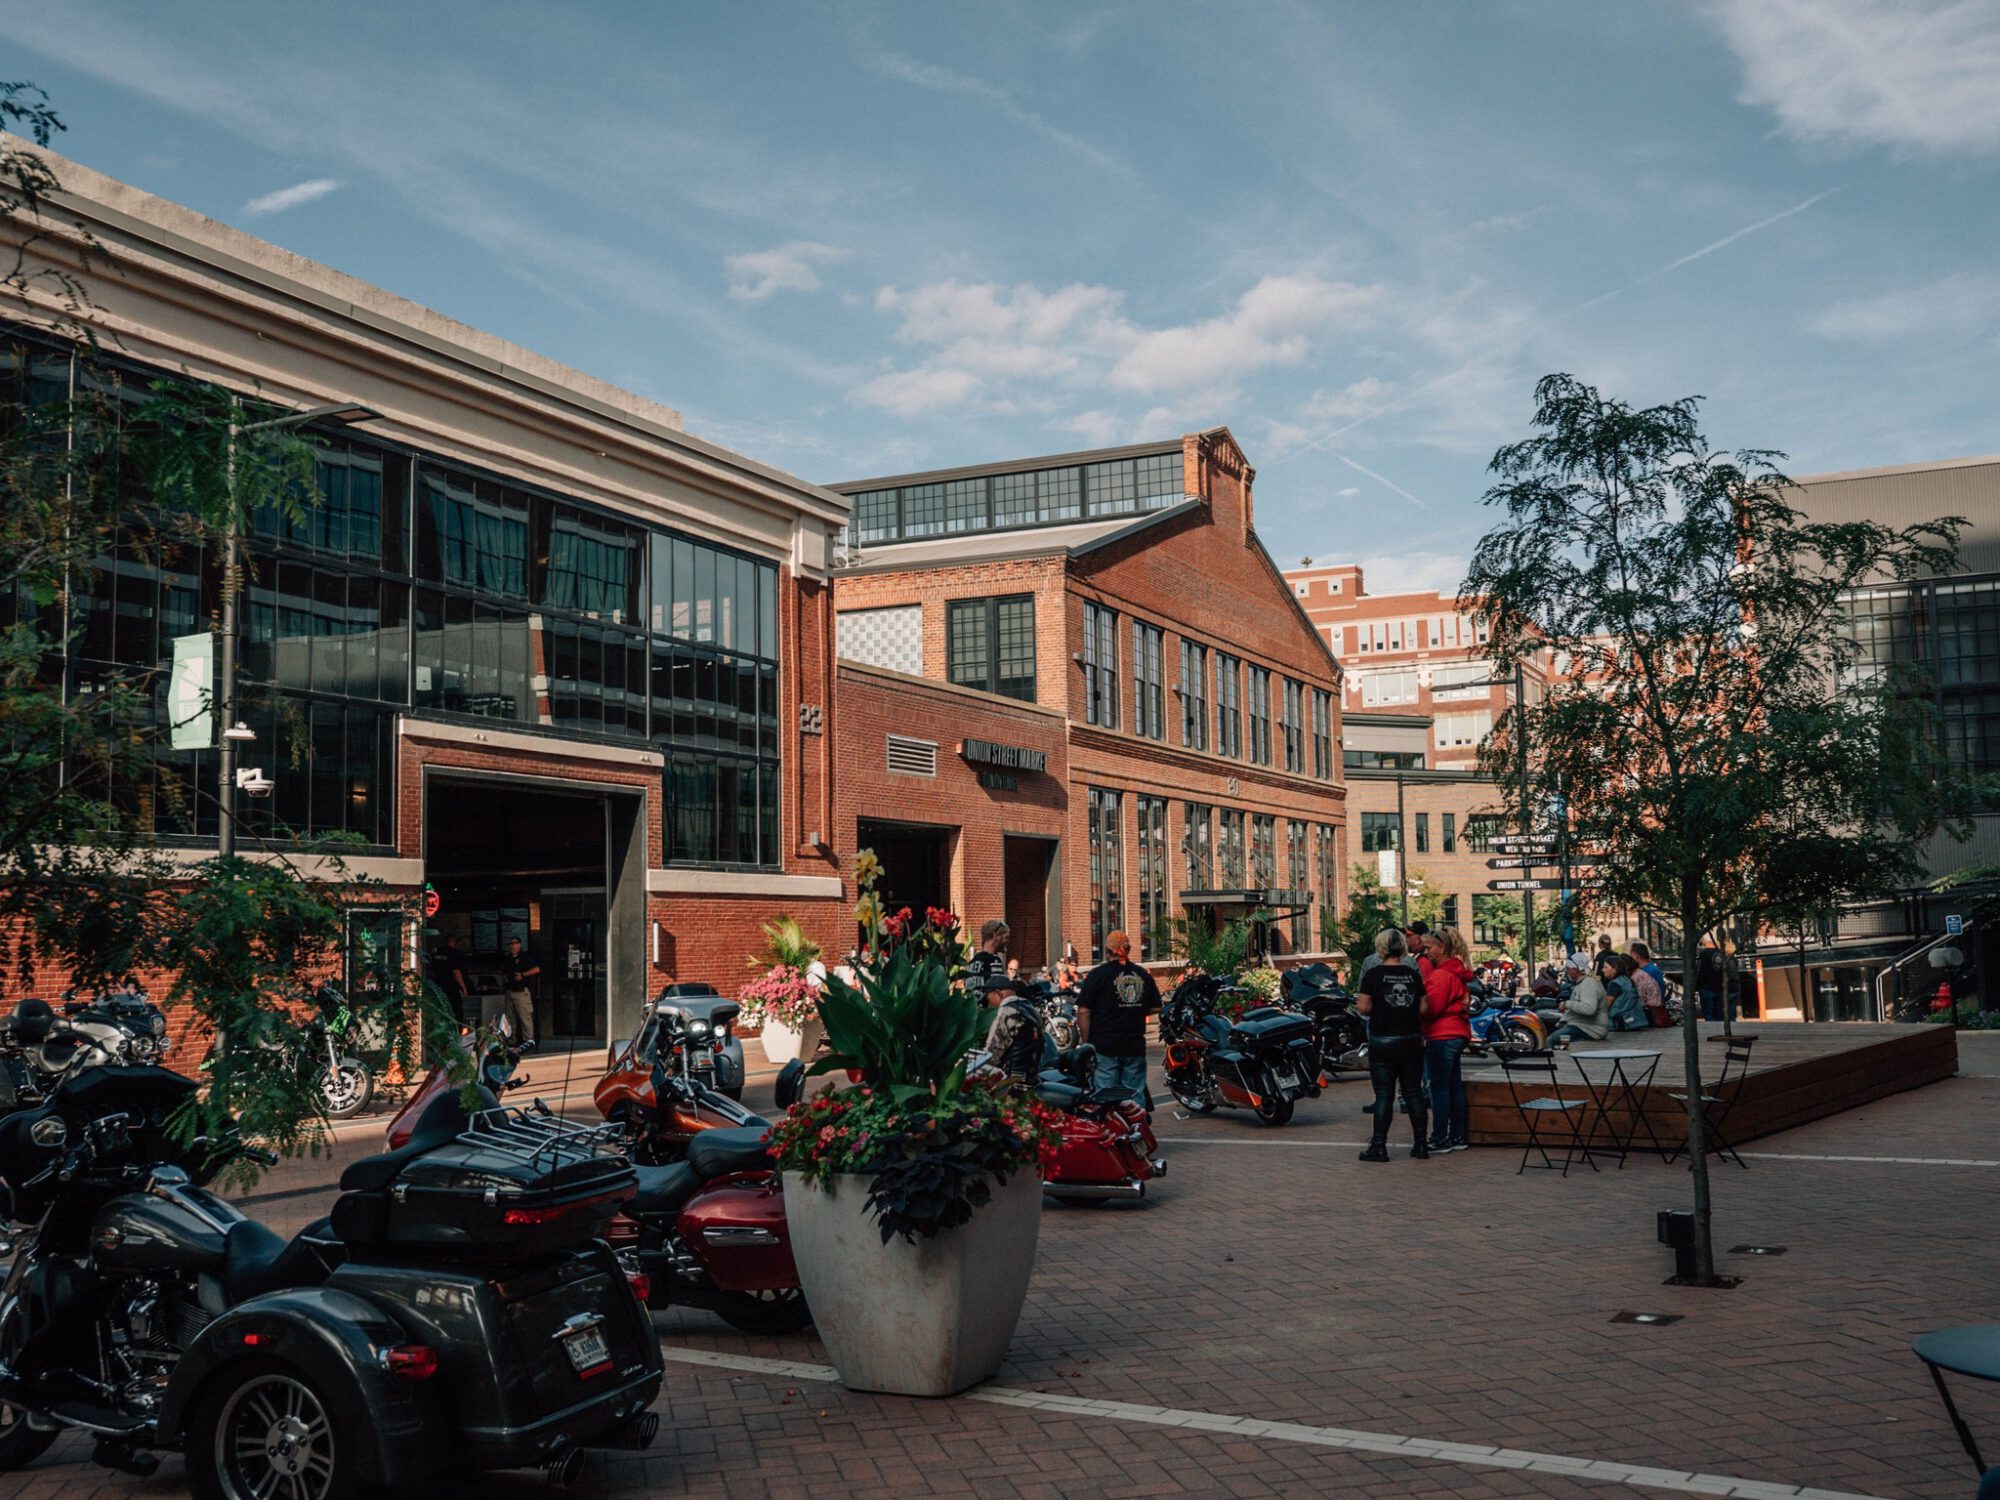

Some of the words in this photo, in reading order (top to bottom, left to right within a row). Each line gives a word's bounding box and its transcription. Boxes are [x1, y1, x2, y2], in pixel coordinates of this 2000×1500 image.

[800, 703, 823, 734] 22
[968, 739, 991, 762] UNION
[992, 744, 1018, 768] STREET
[1488, 837, 1506, 845] UNION
[1496, 859, 1523, 867] PARKING
[1496, 881, 1516, 889] UNION
[1517, 880, 1542, 889] TUNNEL
